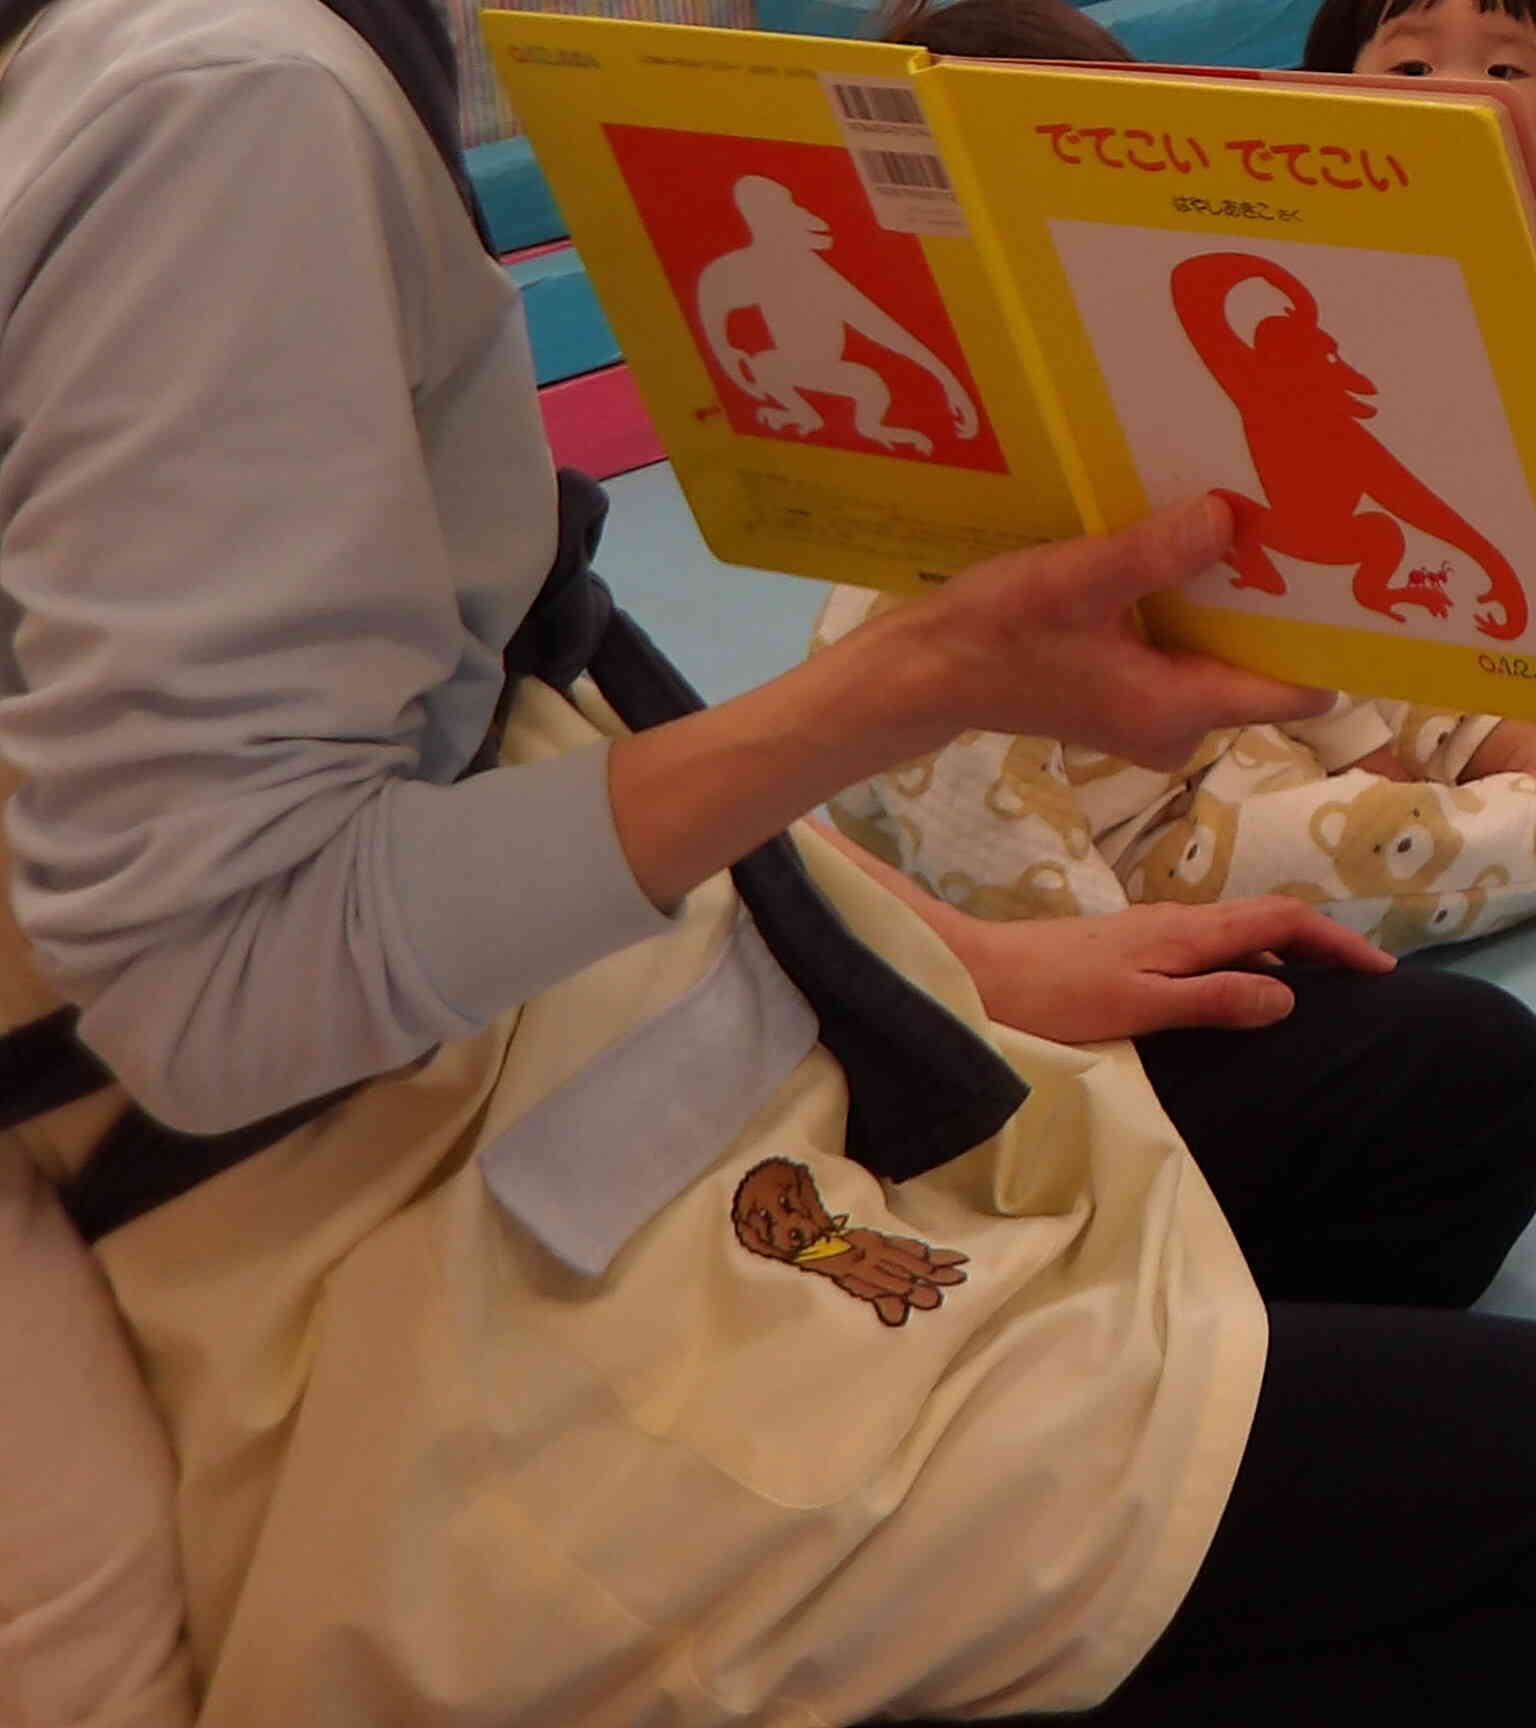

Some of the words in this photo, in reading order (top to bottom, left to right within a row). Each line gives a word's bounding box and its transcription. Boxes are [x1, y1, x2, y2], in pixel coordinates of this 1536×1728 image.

[1035, 123, 1210, 174] でてこい
[1225, 139, 1410, 192] でてこい
